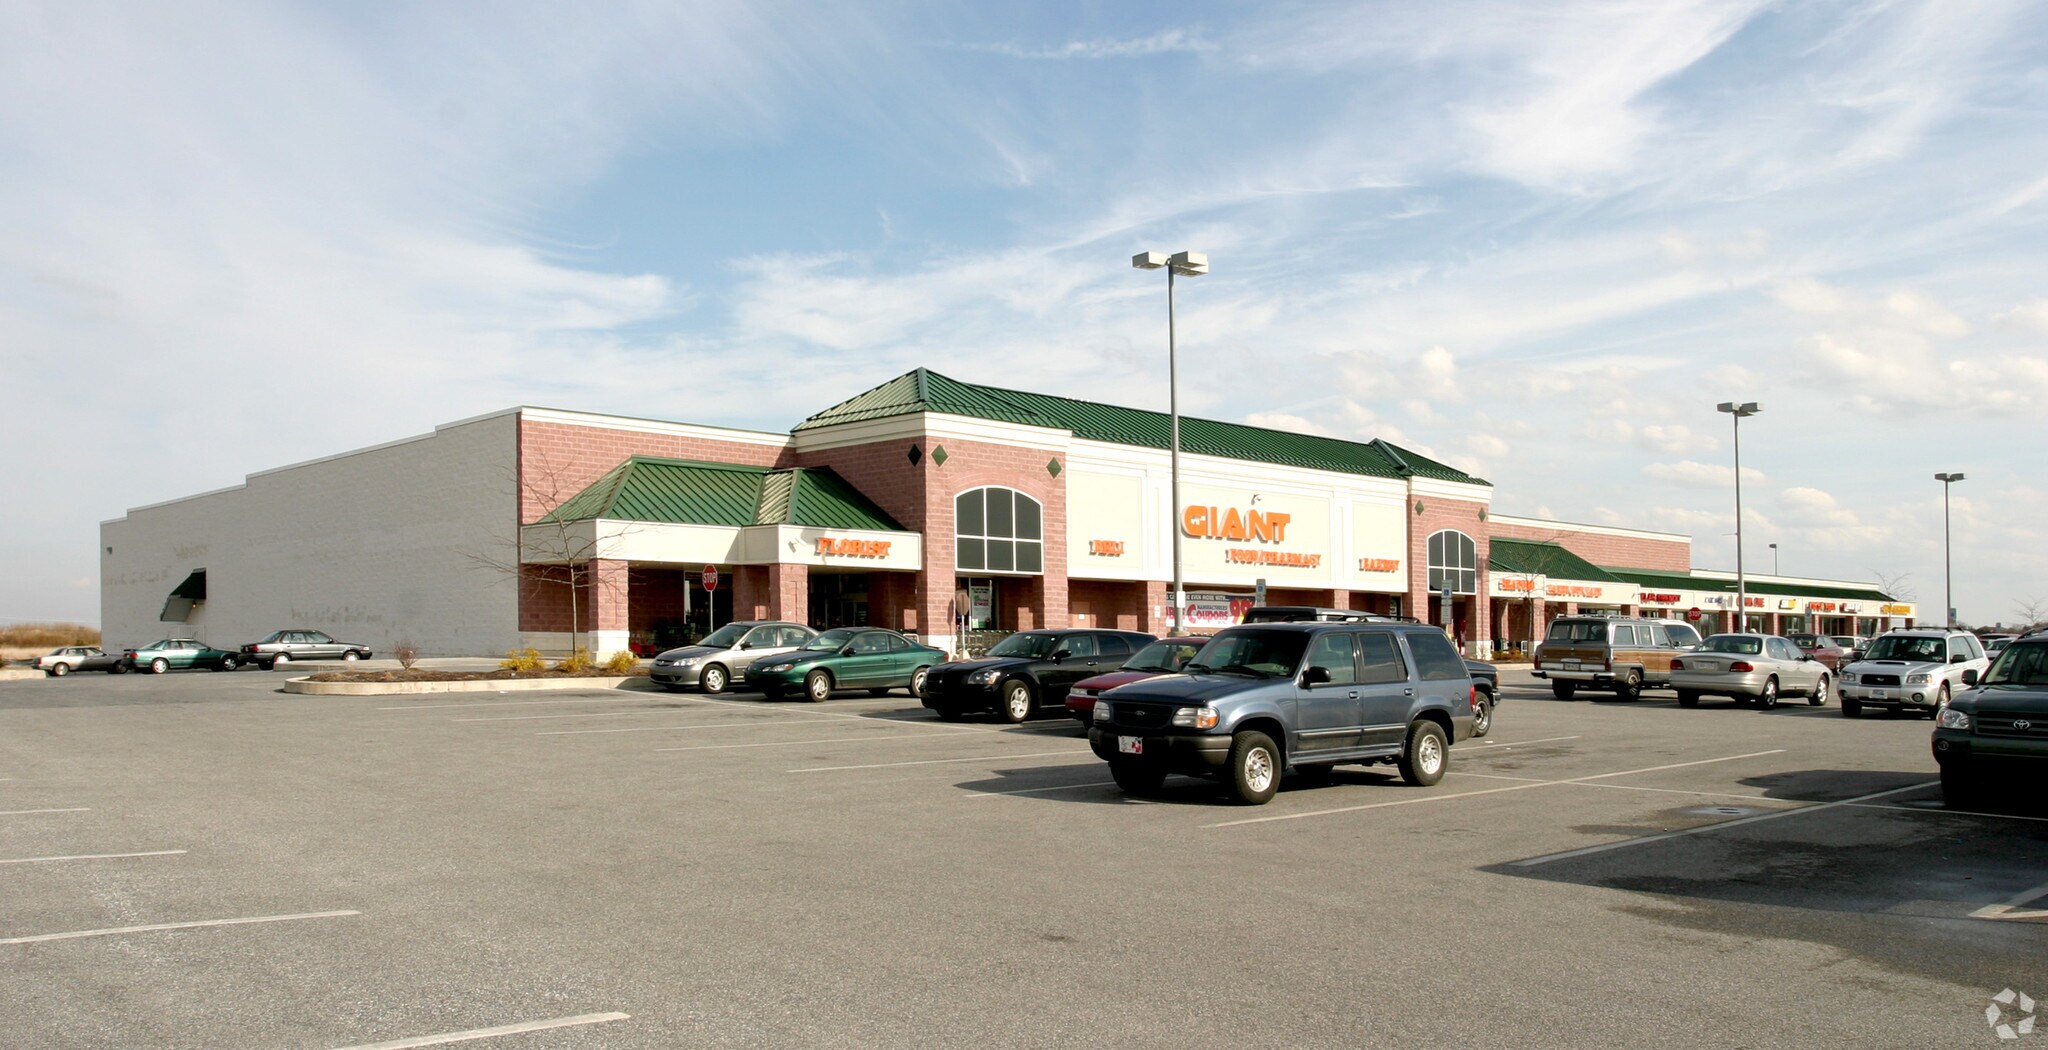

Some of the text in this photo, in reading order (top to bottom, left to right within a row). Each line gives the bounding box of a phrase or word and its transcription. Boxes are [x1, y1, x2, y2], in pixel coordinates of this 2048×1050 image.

[1182, 505, 1291, 543] GIANT
[815, 537, 892, 558] FLORIST
[703, 572, 717, 583] STOP
